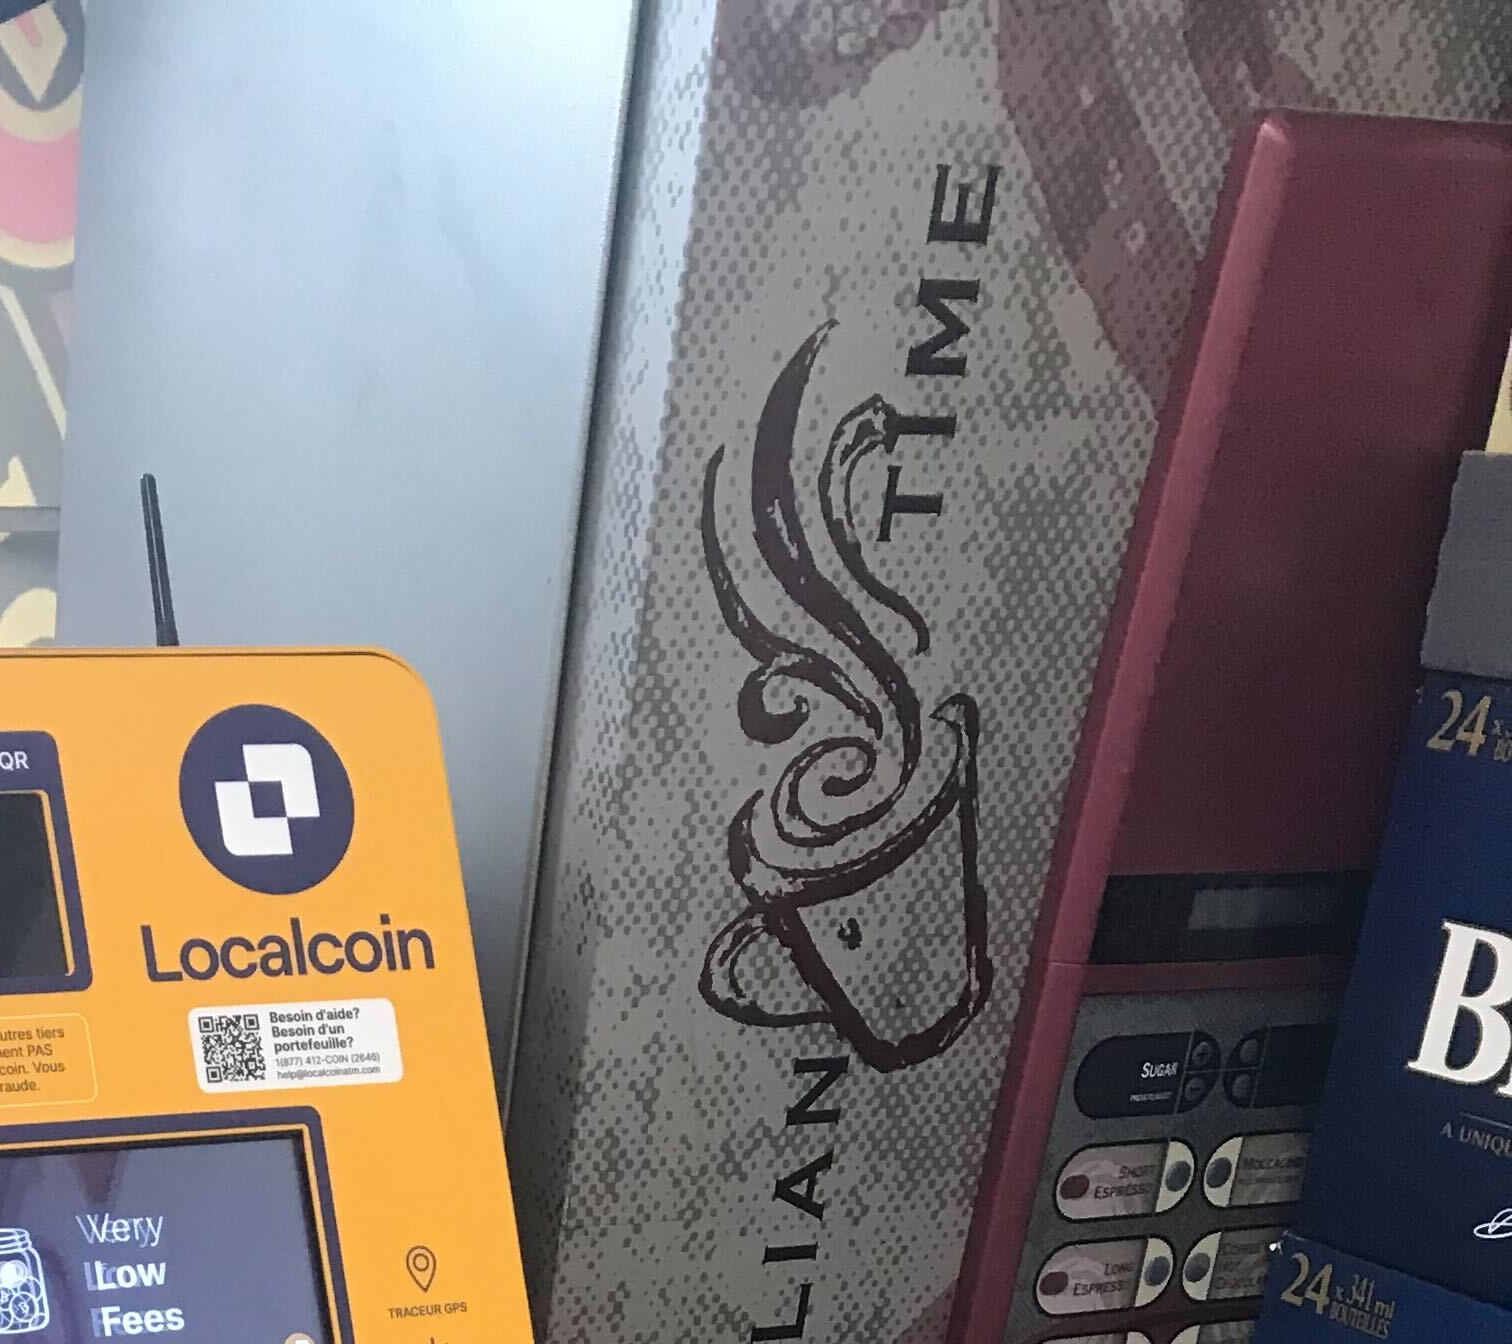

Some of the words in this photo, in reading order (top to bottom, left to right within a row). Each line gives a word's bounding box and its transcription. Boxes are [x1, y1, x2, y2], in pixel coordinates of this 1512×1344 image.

[878, 164, 1001, 542] TIME
[1427, 689, 1492, 756] 24
[140, 914, 435, 983] Localcoin
[269, 1011, 313, 1024] Besoin
[316, 1007, 360, 1021] d'aide?
[36, 1026, 65, 1040] tiers
[271, 1025, 315, 1038] Besoin
[318, 1023, 345, 1035] d'un
[27, 1043, 54, 1057] PAS
[274, 1036, 354, 1055] portefeuille?
[33, 1060, 66, 1075] Vous
[87, 1214, 164, 1248] Very
[95, 1260, 167, 1290] Low
[1281, 1252, 1333, 1315] 24
[388, 1303, 442, 1318] TRACEUR
[445, 1301, 468, 1314] GPS
[102, 1306, 186, 1338] Fees
